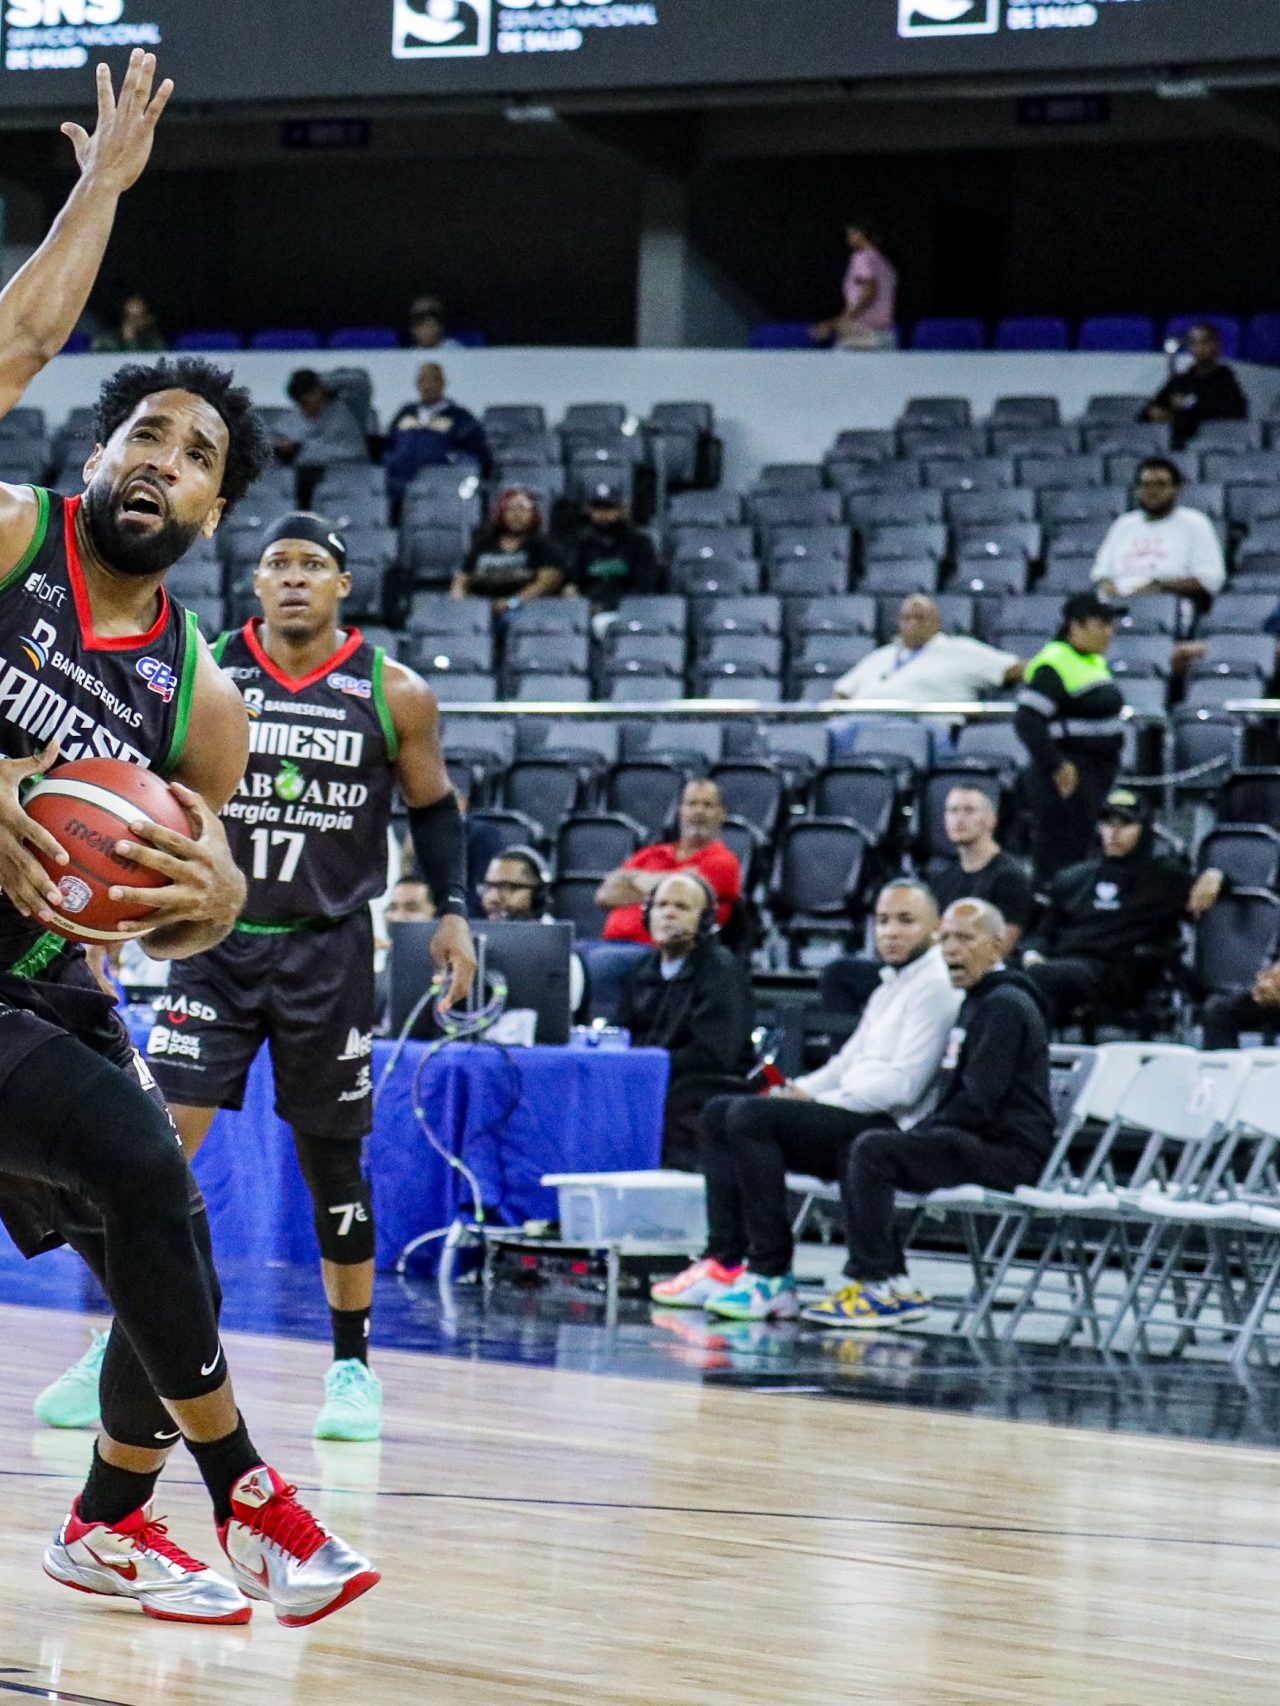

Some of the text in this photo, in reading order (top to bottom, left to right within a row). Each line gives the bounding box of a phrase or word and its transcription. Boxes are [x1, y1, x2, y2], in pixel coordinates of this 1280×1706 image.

[50, 651, 143, 728] BANRESERVAS
[283, 804, 354, 832] Limpia
[249, 827, 306, 883] 17
[167, 1042, 201, 1060] paq
[170, 1030, 201, 1048] box
